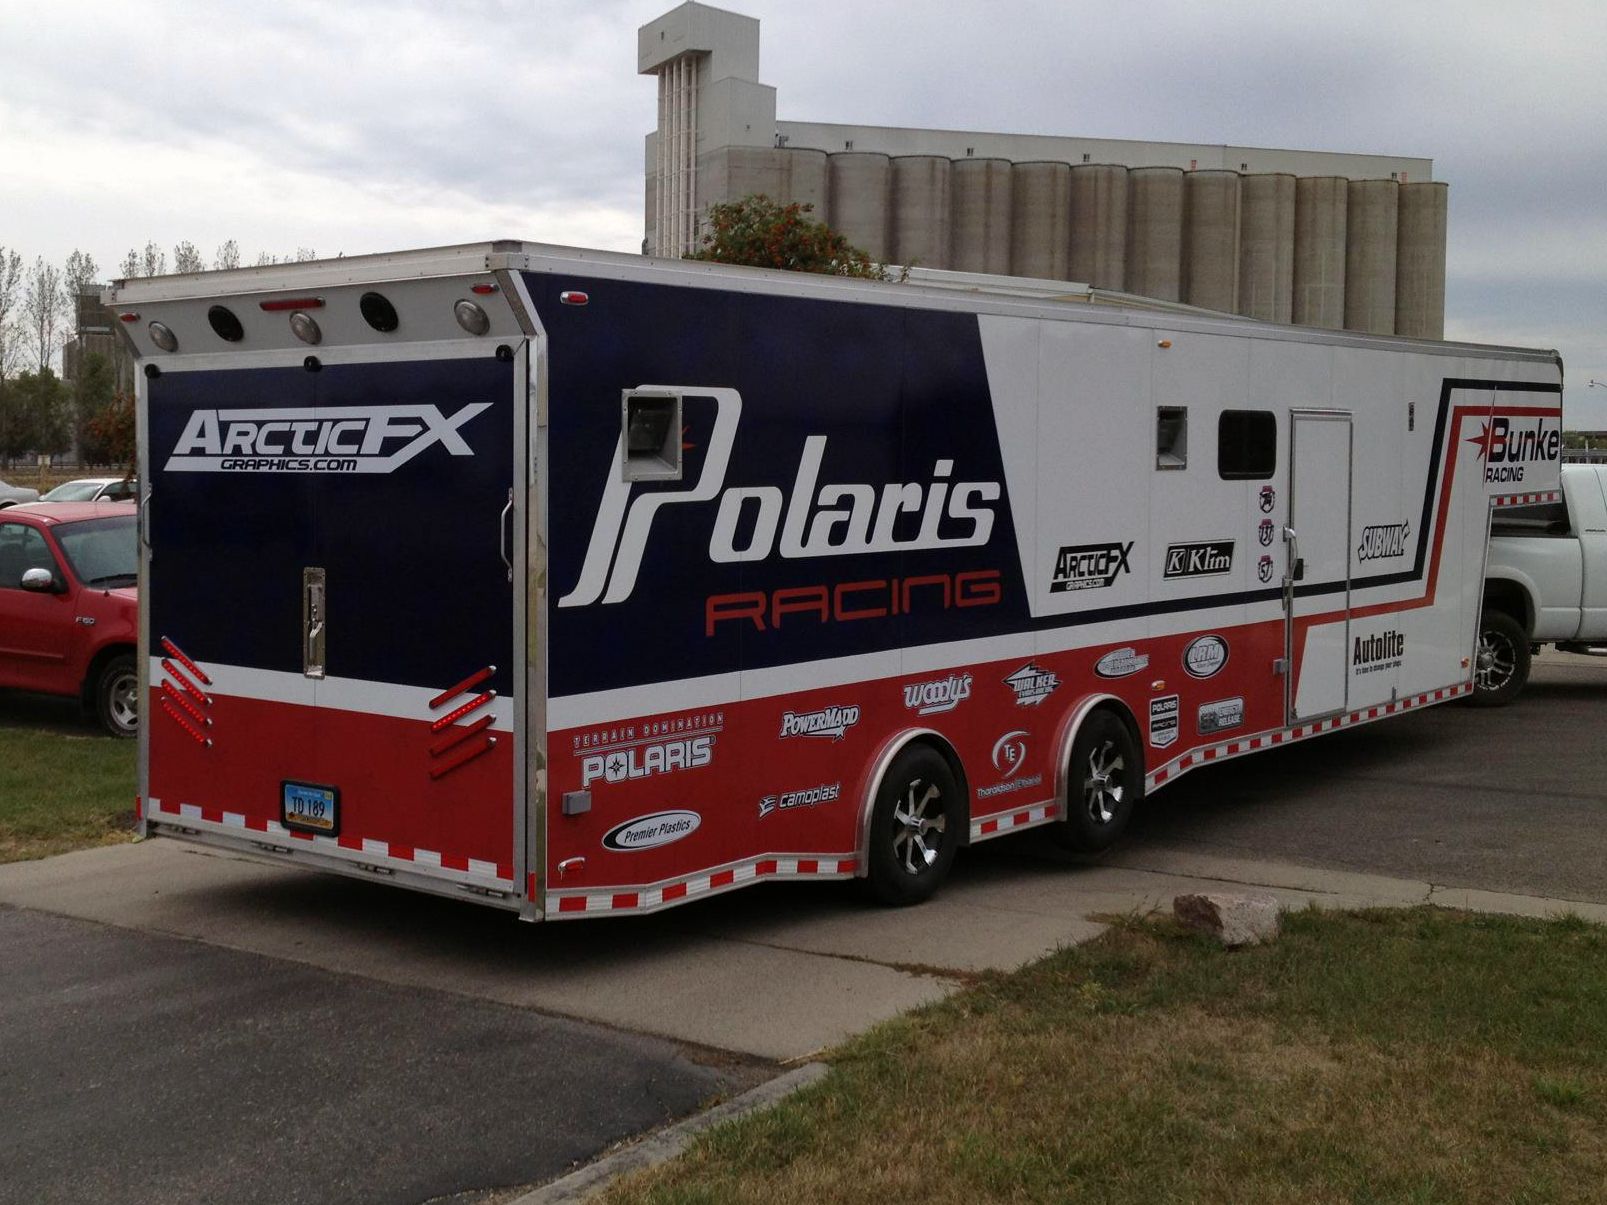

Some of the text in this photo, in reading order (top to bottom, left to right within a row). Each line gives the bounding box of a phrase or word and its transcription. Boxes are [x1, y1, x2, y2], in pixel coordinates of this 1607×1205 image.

[1488, 417, 1559, 463] Bunke
[220, 458, 358, 472] GRAPHICS.COM
[1485, 467, 1524, 483] RACING
[557, 385, 1000, 607] Polaris
[1358, 519, 1410, 563] SUBWAY
[705, 570, 1001, 637] RACING
[1353, 629, 1404, 666] Autolite
[1013, 673, 1057, 692] WALKER
[1151, 700, 1177, 714] POLARIS
[573, 712, 724, 748] TERRAIN DOMINATION
[582, 736, 712, 788] POLARIS
[292, 796, 325, 817] TD 189
[778, 783, 841, 809] camoplast
[624, 819, 691, 844] Premier Plastics
